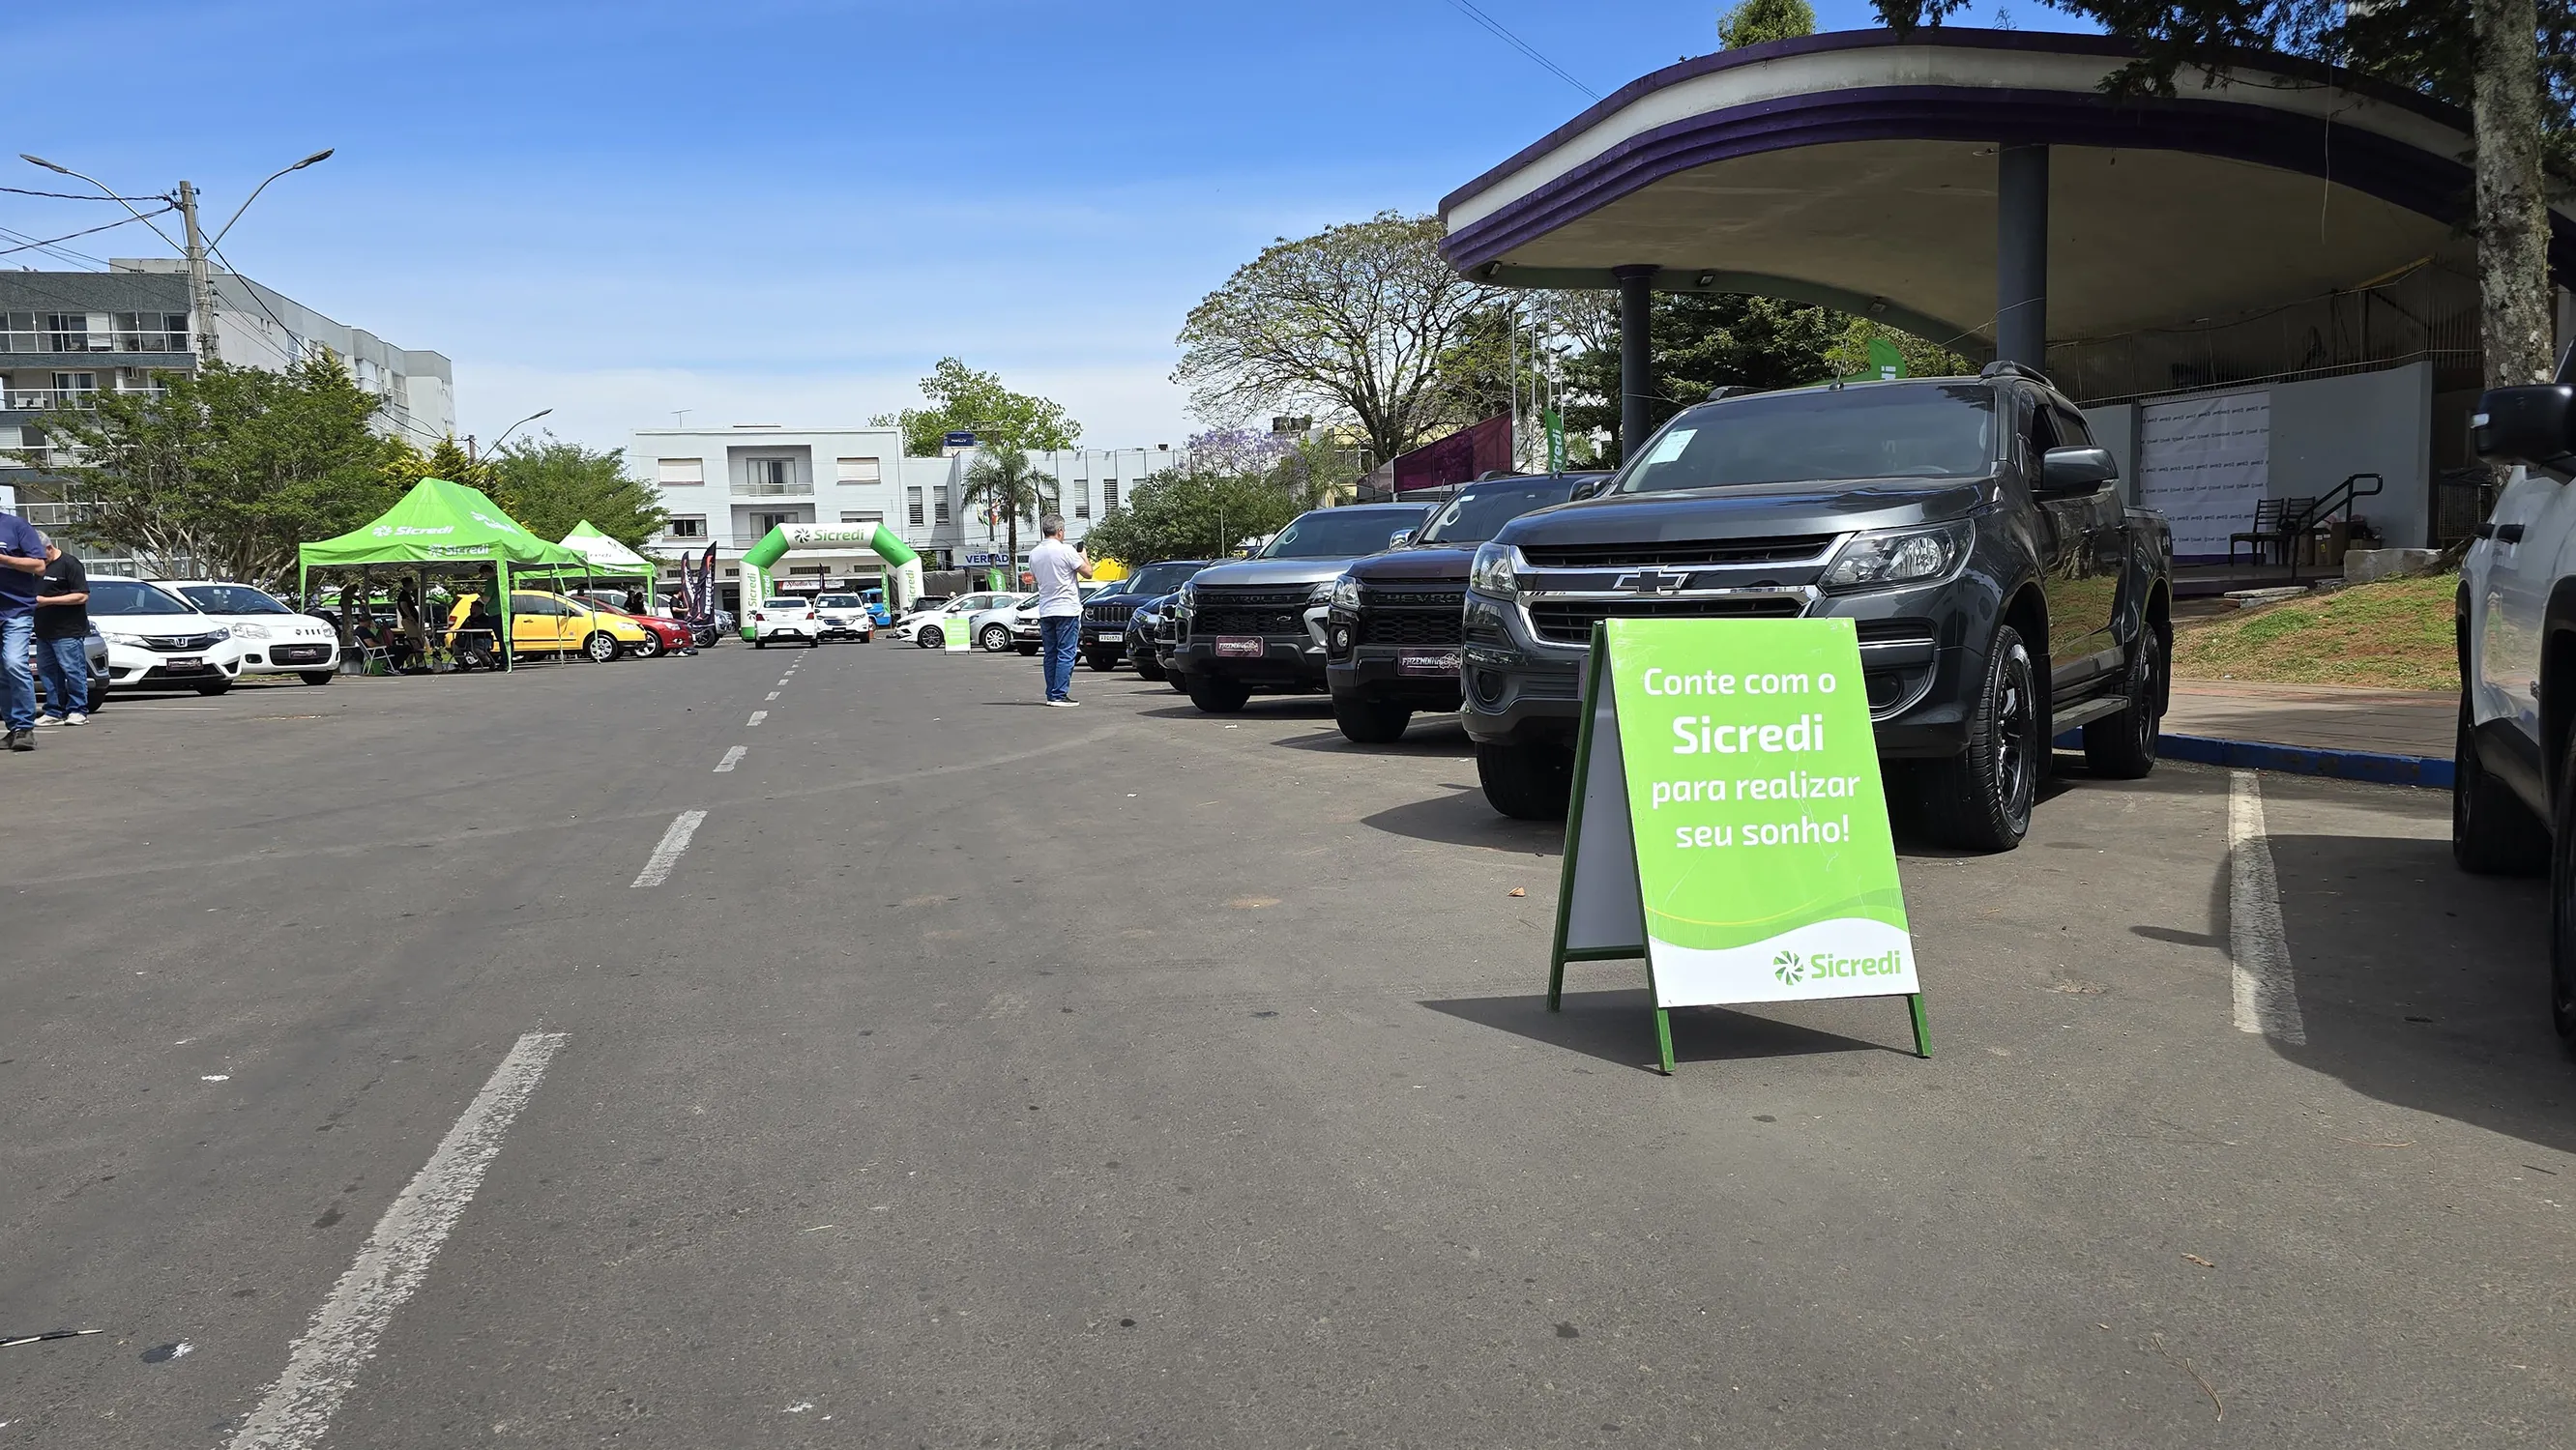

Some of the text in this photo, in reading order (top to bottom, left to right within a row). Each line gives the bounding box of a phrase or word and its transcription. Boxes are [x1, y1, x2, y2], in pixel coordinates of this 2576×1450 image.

[1552, 428, 1563, 473] credi
[395, 525, 454, 536] Sicredi
[813, 528, 864, 541] Sicredi
[444, 543, 489, 556] Sicredi
[747, 572, 757, 608] Sicredi
[1201, 594, 1294, 604] CHEVROLET
[1374, 594, 1465, 603] CHEVRO
[1643, 667, 1836, 696] Conte com o
[1672, 713, 1824, 754] Sicredi
[1652, 770, 1860, 809] para realizar
[1676, 814, 1850, 849] seu sonho!
[1810, 950, 1901, 979] Sicredi
